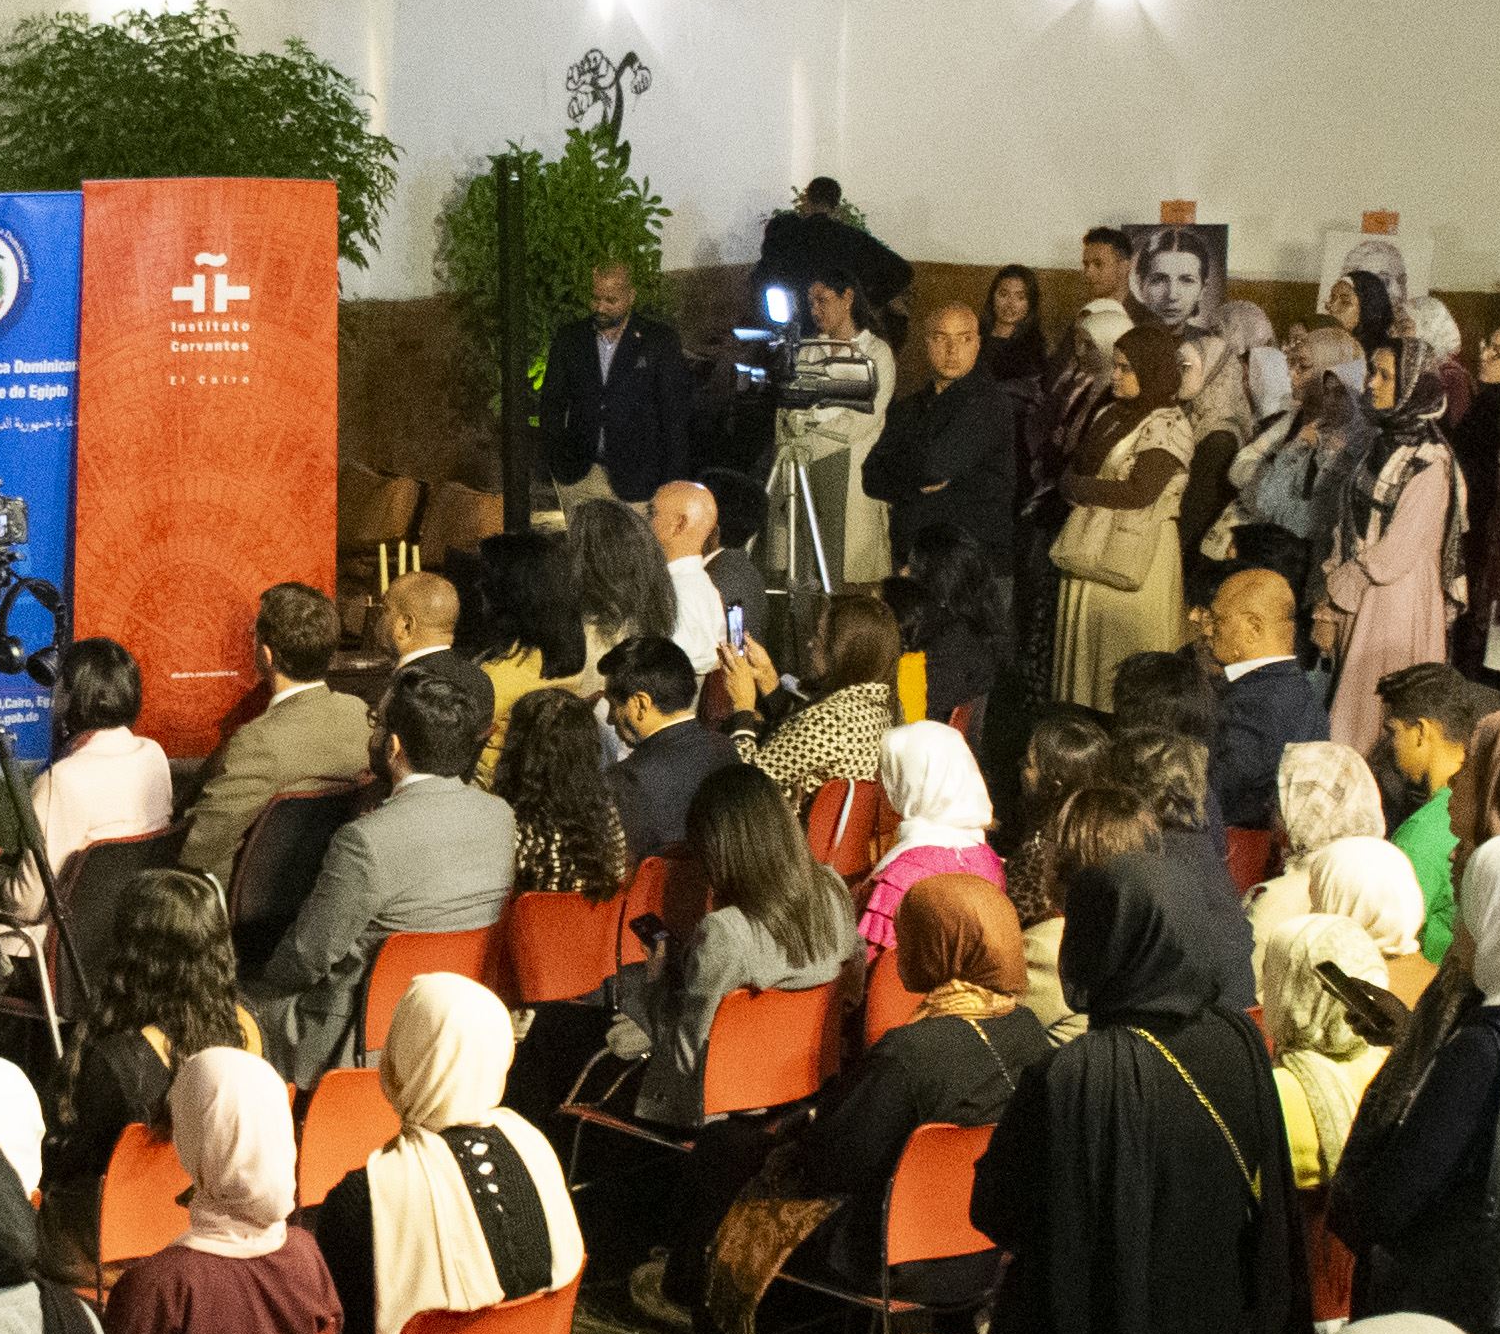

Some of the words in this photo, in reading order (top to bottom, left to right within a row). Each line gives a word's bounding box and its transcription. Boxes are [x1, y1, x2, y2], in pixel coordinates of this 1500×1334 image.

[170, 320, 250, 333] Instituto
[170, 340, 249, 353] Cervantes
[13, 359, 78, 374] Dominican
[170, 375, 186, 385] El
[197, 375, 250, 385] Cairo
[8, 384, 26, 399] de
[28, 384, 68, 401] Egipto
[14, 416, 54, 434] جمهورية
